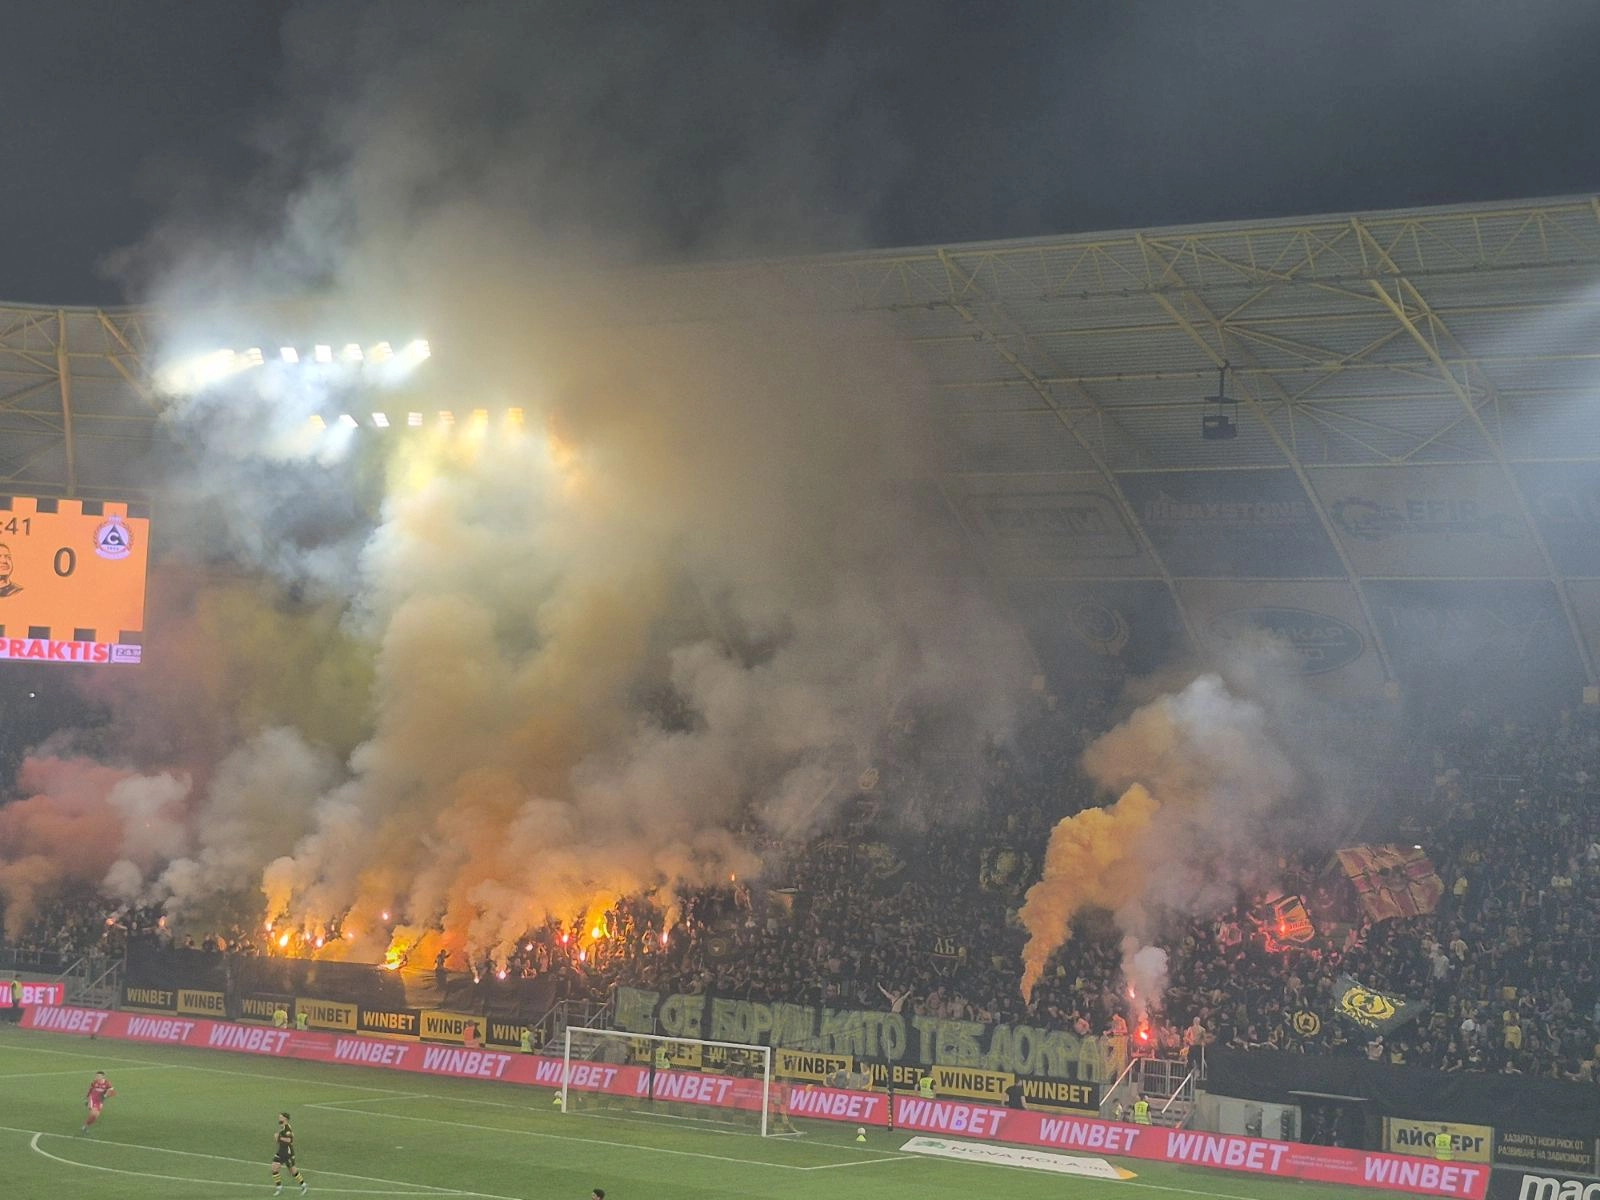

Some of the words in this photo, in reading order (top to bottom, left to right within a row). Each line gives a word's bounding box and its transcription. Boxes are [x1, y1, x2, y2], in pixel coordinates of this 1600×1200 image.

[54, 547, 77, 577] 0
[0, 986, 59, 1005] IBET
[127, 987, 173, 1006] WINBET
[184, 993, 223, 1010] WINBE
[33, 1006, 109, 1033] WINBET
[303, 1005, 351, 1025] INBET
[363, 1011, 415, 1031] WINBET
[127, 1017, 195, 1041] WINBET
[208, 1024, 290, 1053] WINBET
[334, 1039, 409, 1065] WINBET
[423, 1047, 511, 1078] WINBET
[636, 1071, 733, 1103] WINBET
[940, 1071, 1007, 1094] WINBET
[1021, 1079, 1092, 1104] WINBET
[788, 1088, 879, 1119] WINBET
[898, 1099, 1007, 1136] WINBET
[1039, 1118, 1140, 1151] WINBET
[1396, 1127, 1484, 1152] АЙСЕРГ
[1166, 1132, 1289, 1171] WINBET
[1363, 1156, 1480, 1194] WINBET
